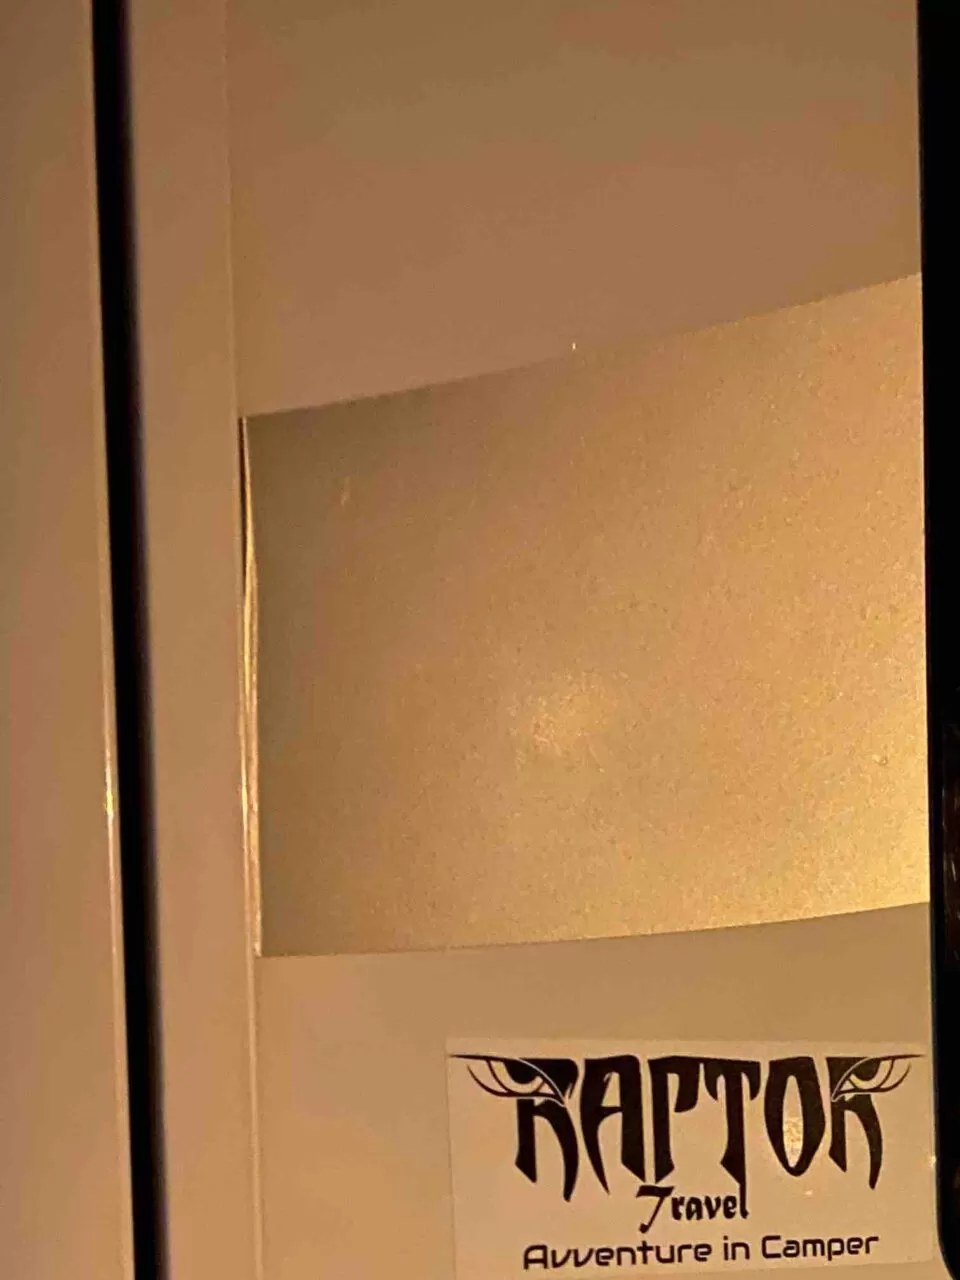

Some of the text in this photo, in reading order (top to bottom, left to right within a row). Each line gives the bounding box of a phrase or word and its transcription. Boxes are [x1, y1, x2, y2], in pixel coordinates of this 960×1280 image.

[452, 1054, 924, 1202] RAPTOR
[635, 1184, 749, 1234] Travel
[523, 1234, 880, 1270] Avventure in Camper
